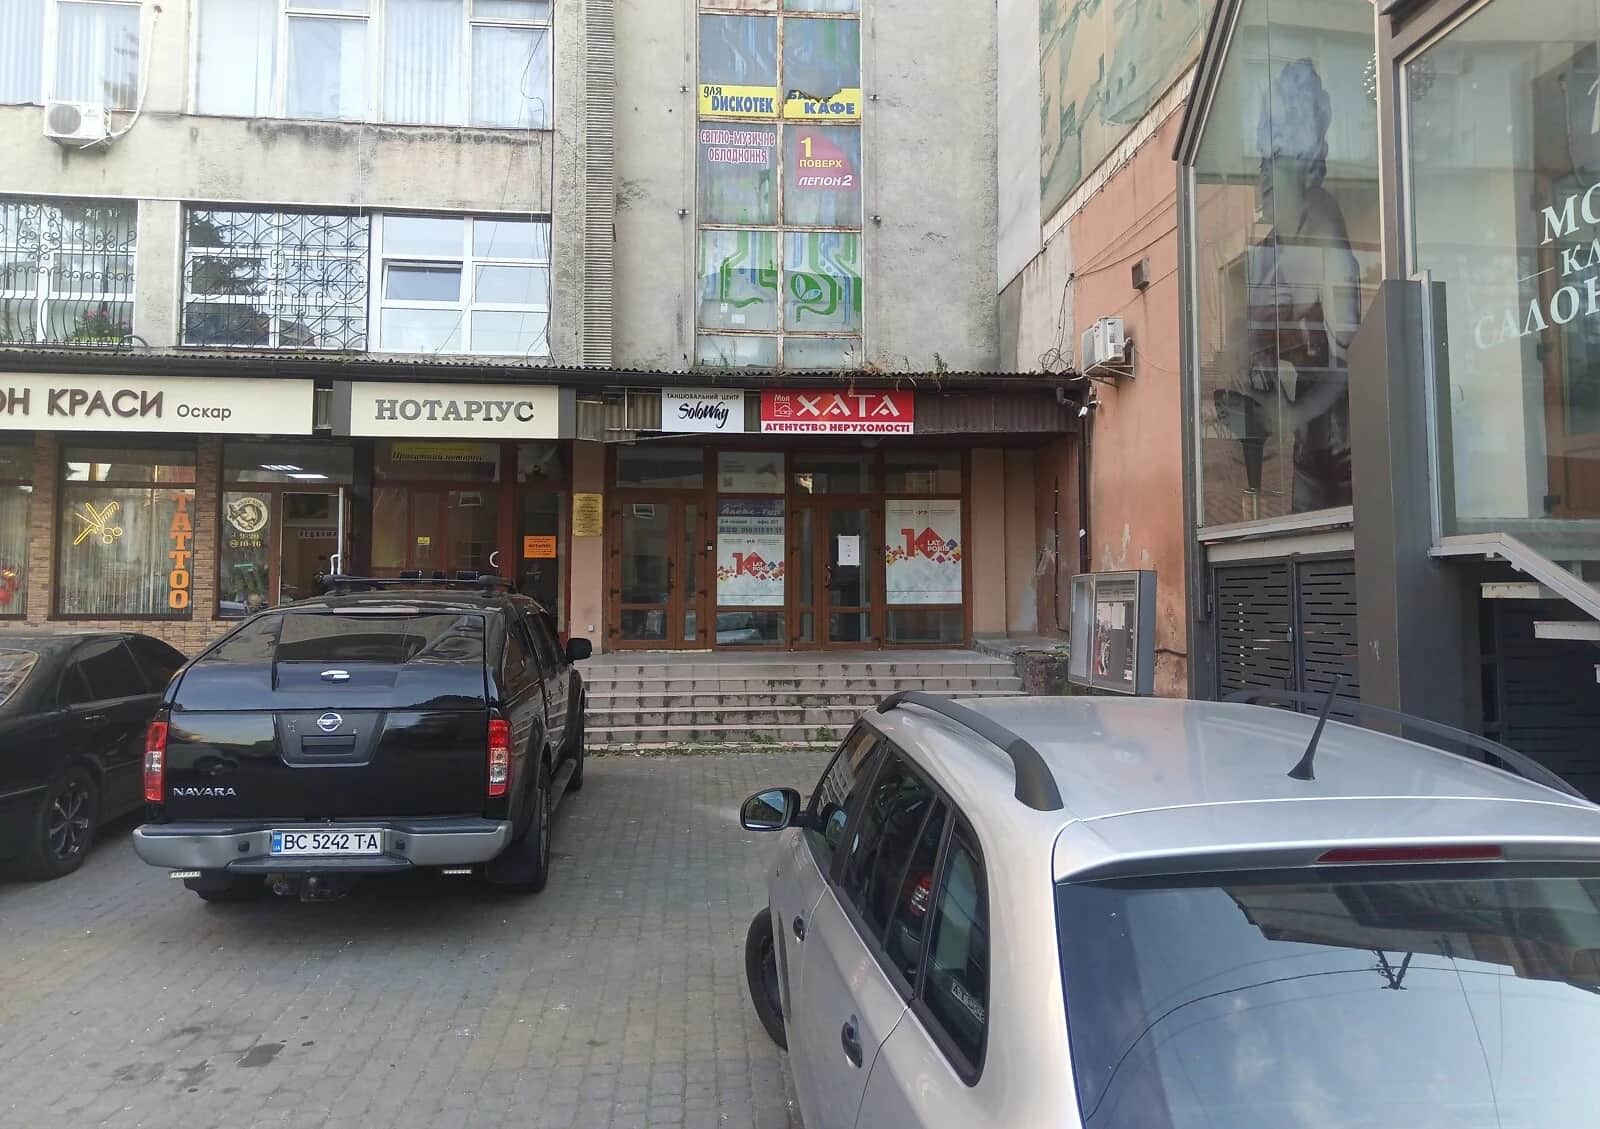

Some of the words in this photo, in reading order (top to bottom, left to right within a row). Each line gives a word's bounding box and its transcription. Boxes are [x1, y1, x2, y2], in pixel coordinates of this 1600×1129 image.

[804, 101, 855, 115] КАФЕ
[800, 136, 813, 158] 1
[799, 159, 842, 169] ПОВЕРХ
[47, 388, 164, 418] КРАСИ
[176, 403, 232, 421] Оскар
[721, 393, 740, 401] ЦЕНТР
[374, 399, 535, 423] НОТАРІУС
[796, 393, 901, 418] ХАТА
[764, 423, 828, 432] АГЕНТСТВО
[829, 423, 911, 433] НЕРУХОМОСТІ
[169, 493, 193, 609] TATTOO
[173, 787, 237, 796] NAVARA
[284, 834, 307, 850] BC
[312, 834, 349, 850] 5242
[354, 834, 378, 849] TA
